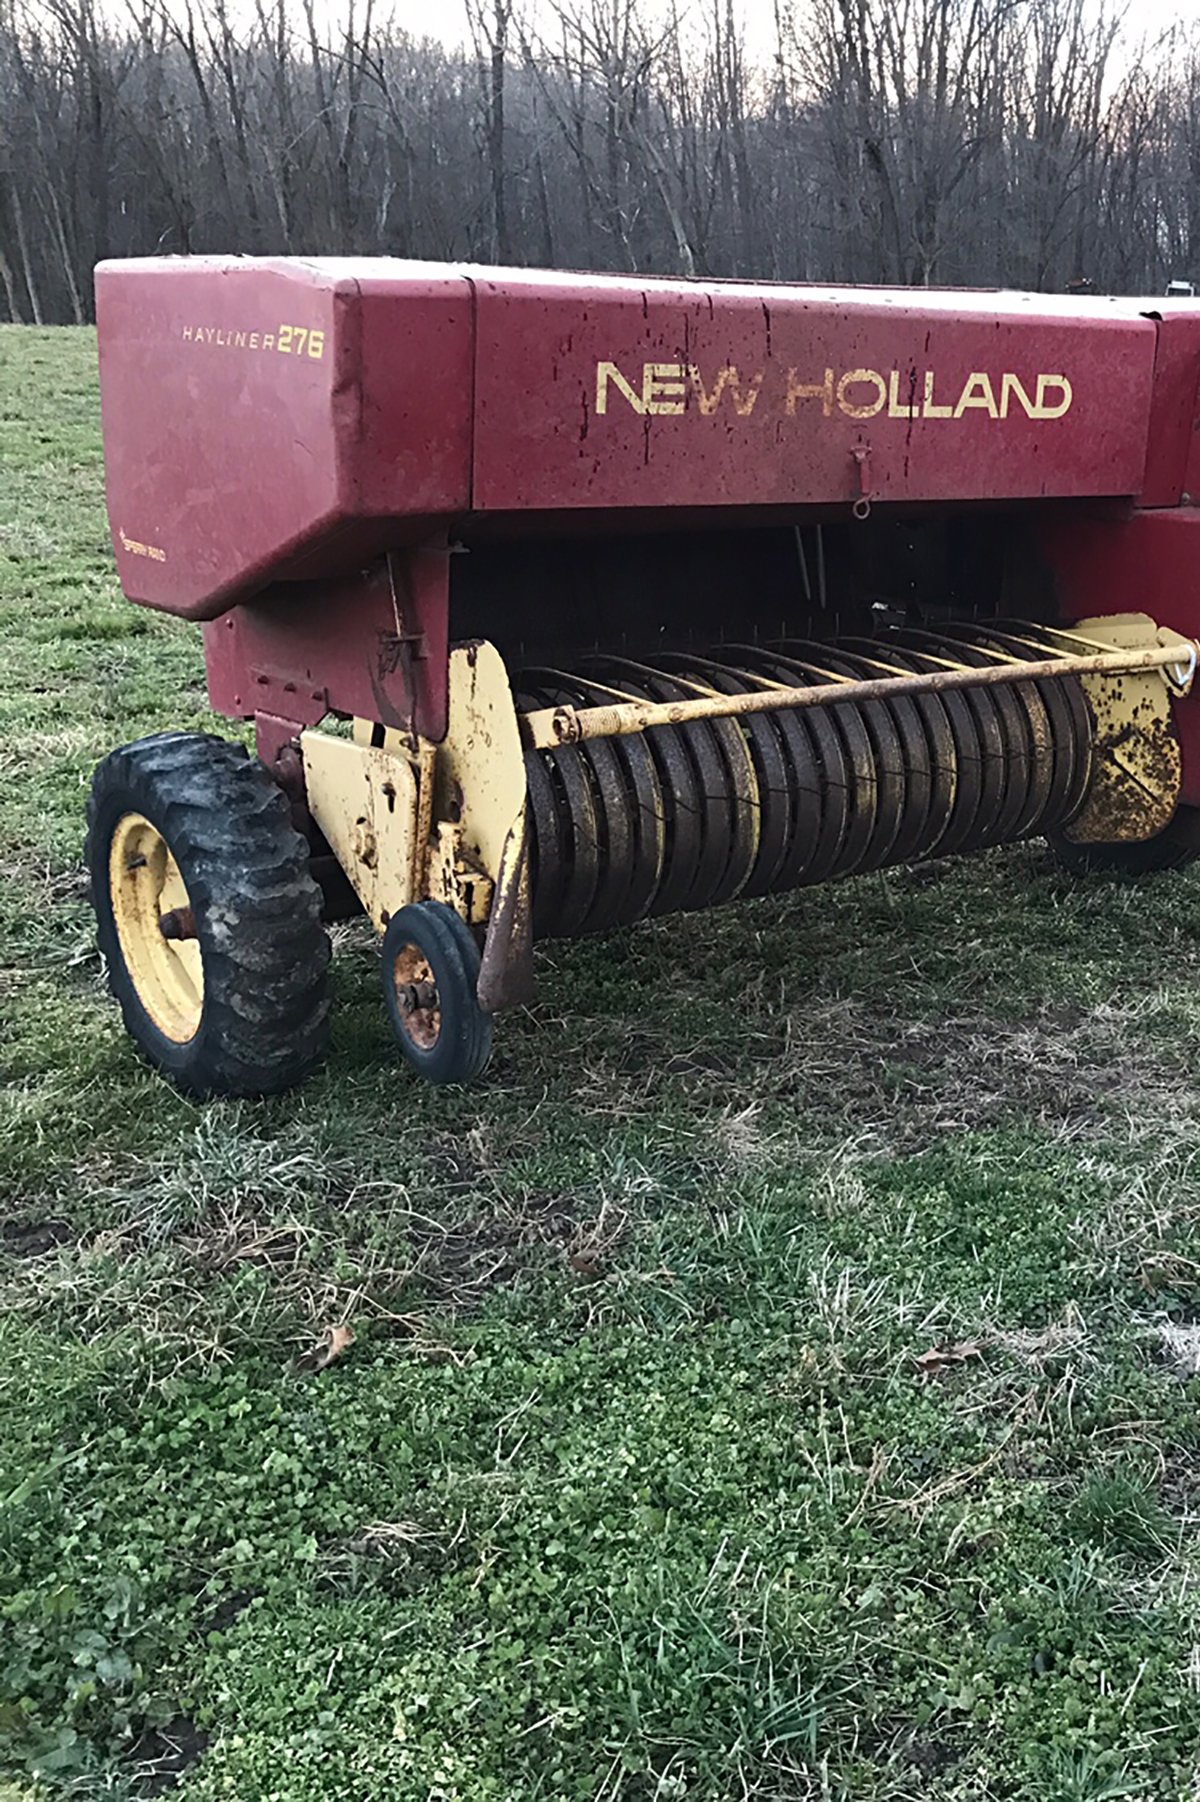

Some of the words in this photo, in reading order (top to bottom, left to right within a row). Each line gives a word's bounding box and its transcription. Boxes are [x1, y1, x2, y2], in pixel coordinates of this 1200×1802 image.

[183, 325, 275, 350] HAYLINER
[277, 324, 325, 359] 276
[596, 361, 765, 415] NEW
[786, 367, 1073, 419] HOLLAND
